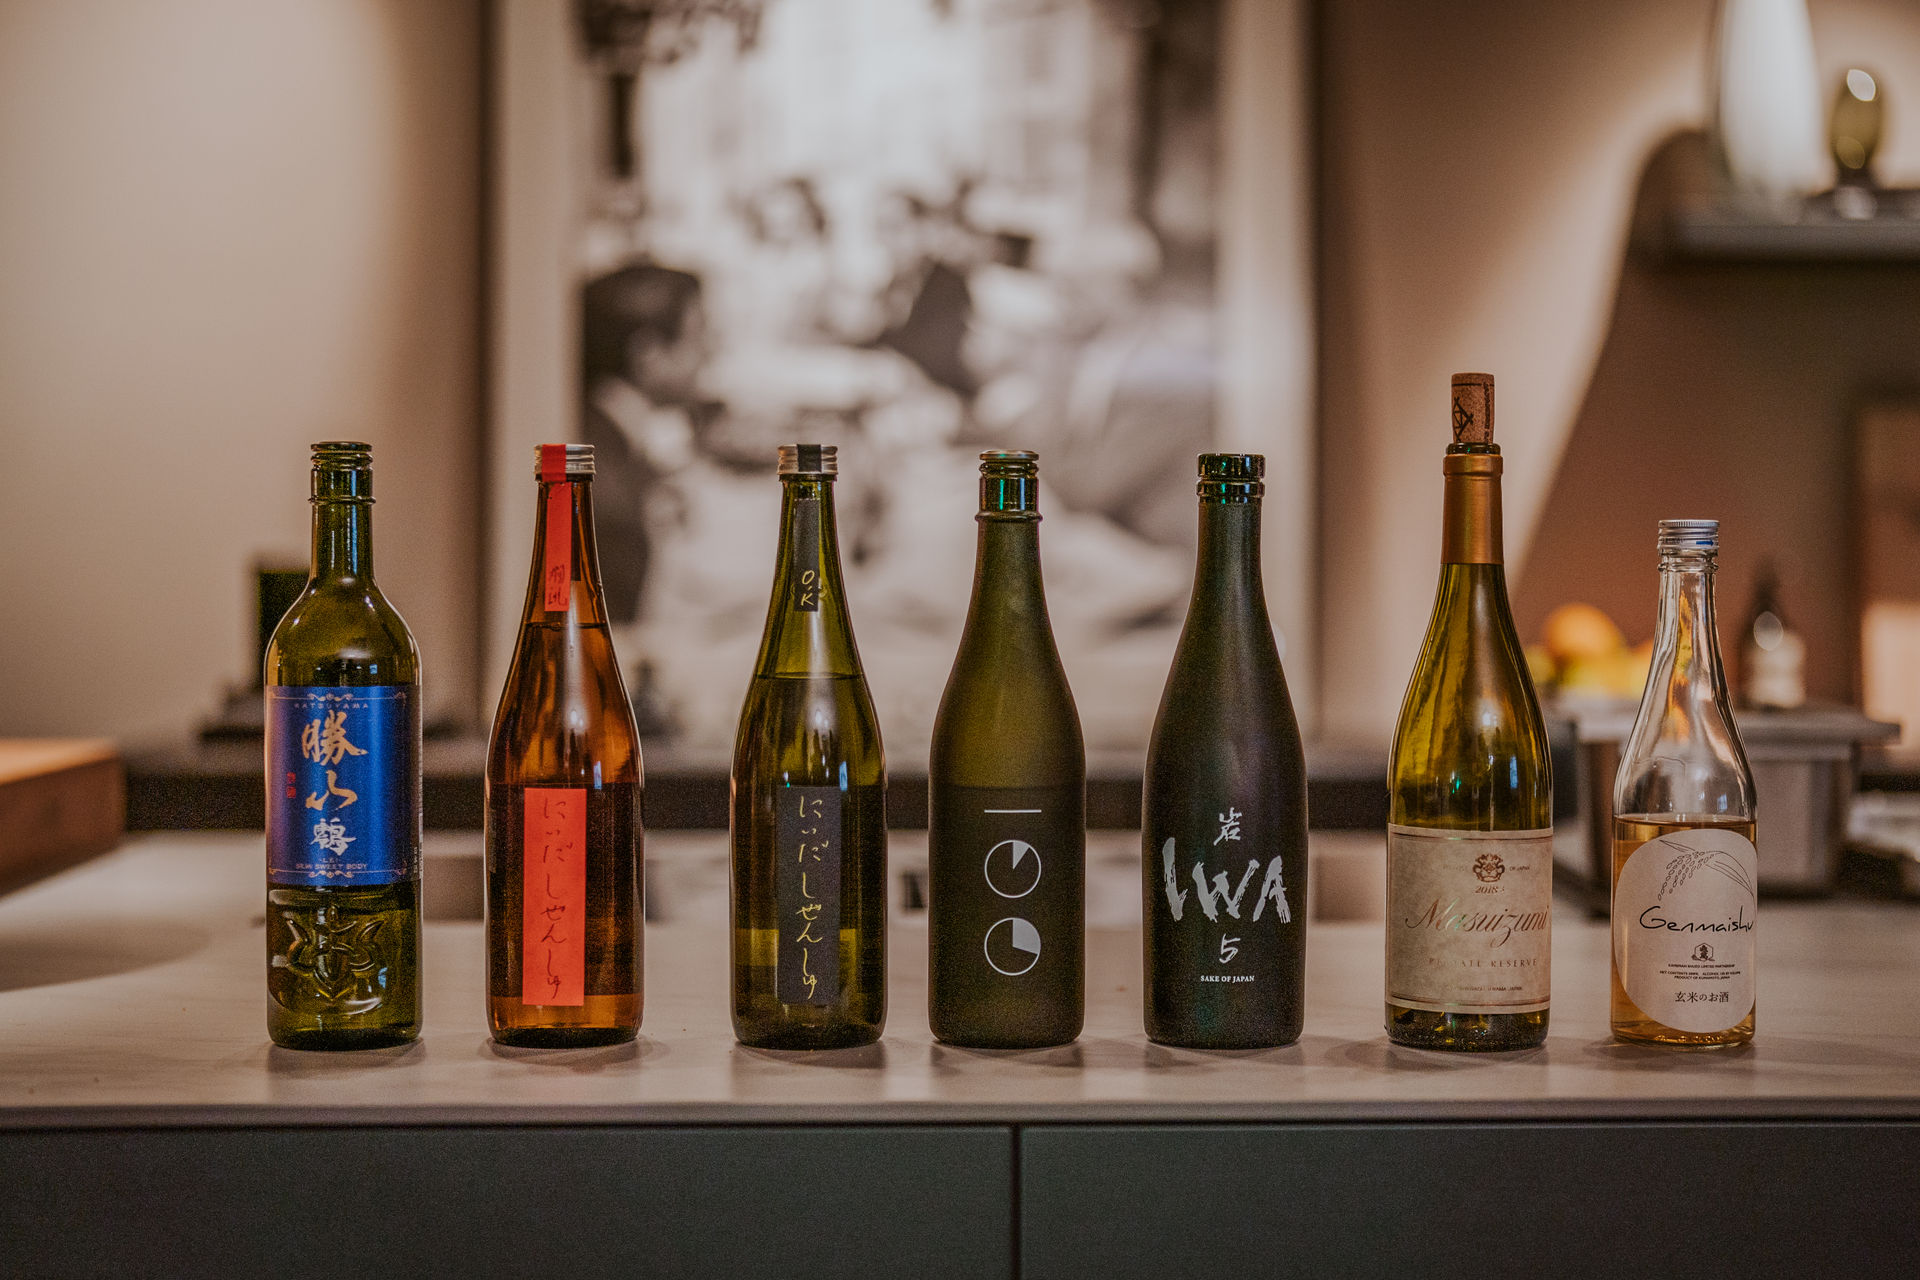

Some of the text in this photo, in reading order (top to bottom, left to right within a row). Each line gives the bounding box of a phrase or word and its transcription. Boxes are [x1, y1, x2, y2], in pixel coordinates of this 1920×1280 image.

[1213, 806, 1243, 846] 岩
[1162, 836, 1291, 924] IWA
[1475, 885, 1499, 894] 2018
[796, 795, 829, 1000] にいだしぜんしゅ
[1405, 898, 1550, 949] Masuizumi
[1639, 904, 1755, 934] Genmaishu
[1218, 932, 1241, 964] 5
[1490, 957, 1538, 969] RESERVE
[1200, 974, 1255, 984] SAKE OF JAPAN
[1674, 991, 1730, 1003] 玄米のお酒
